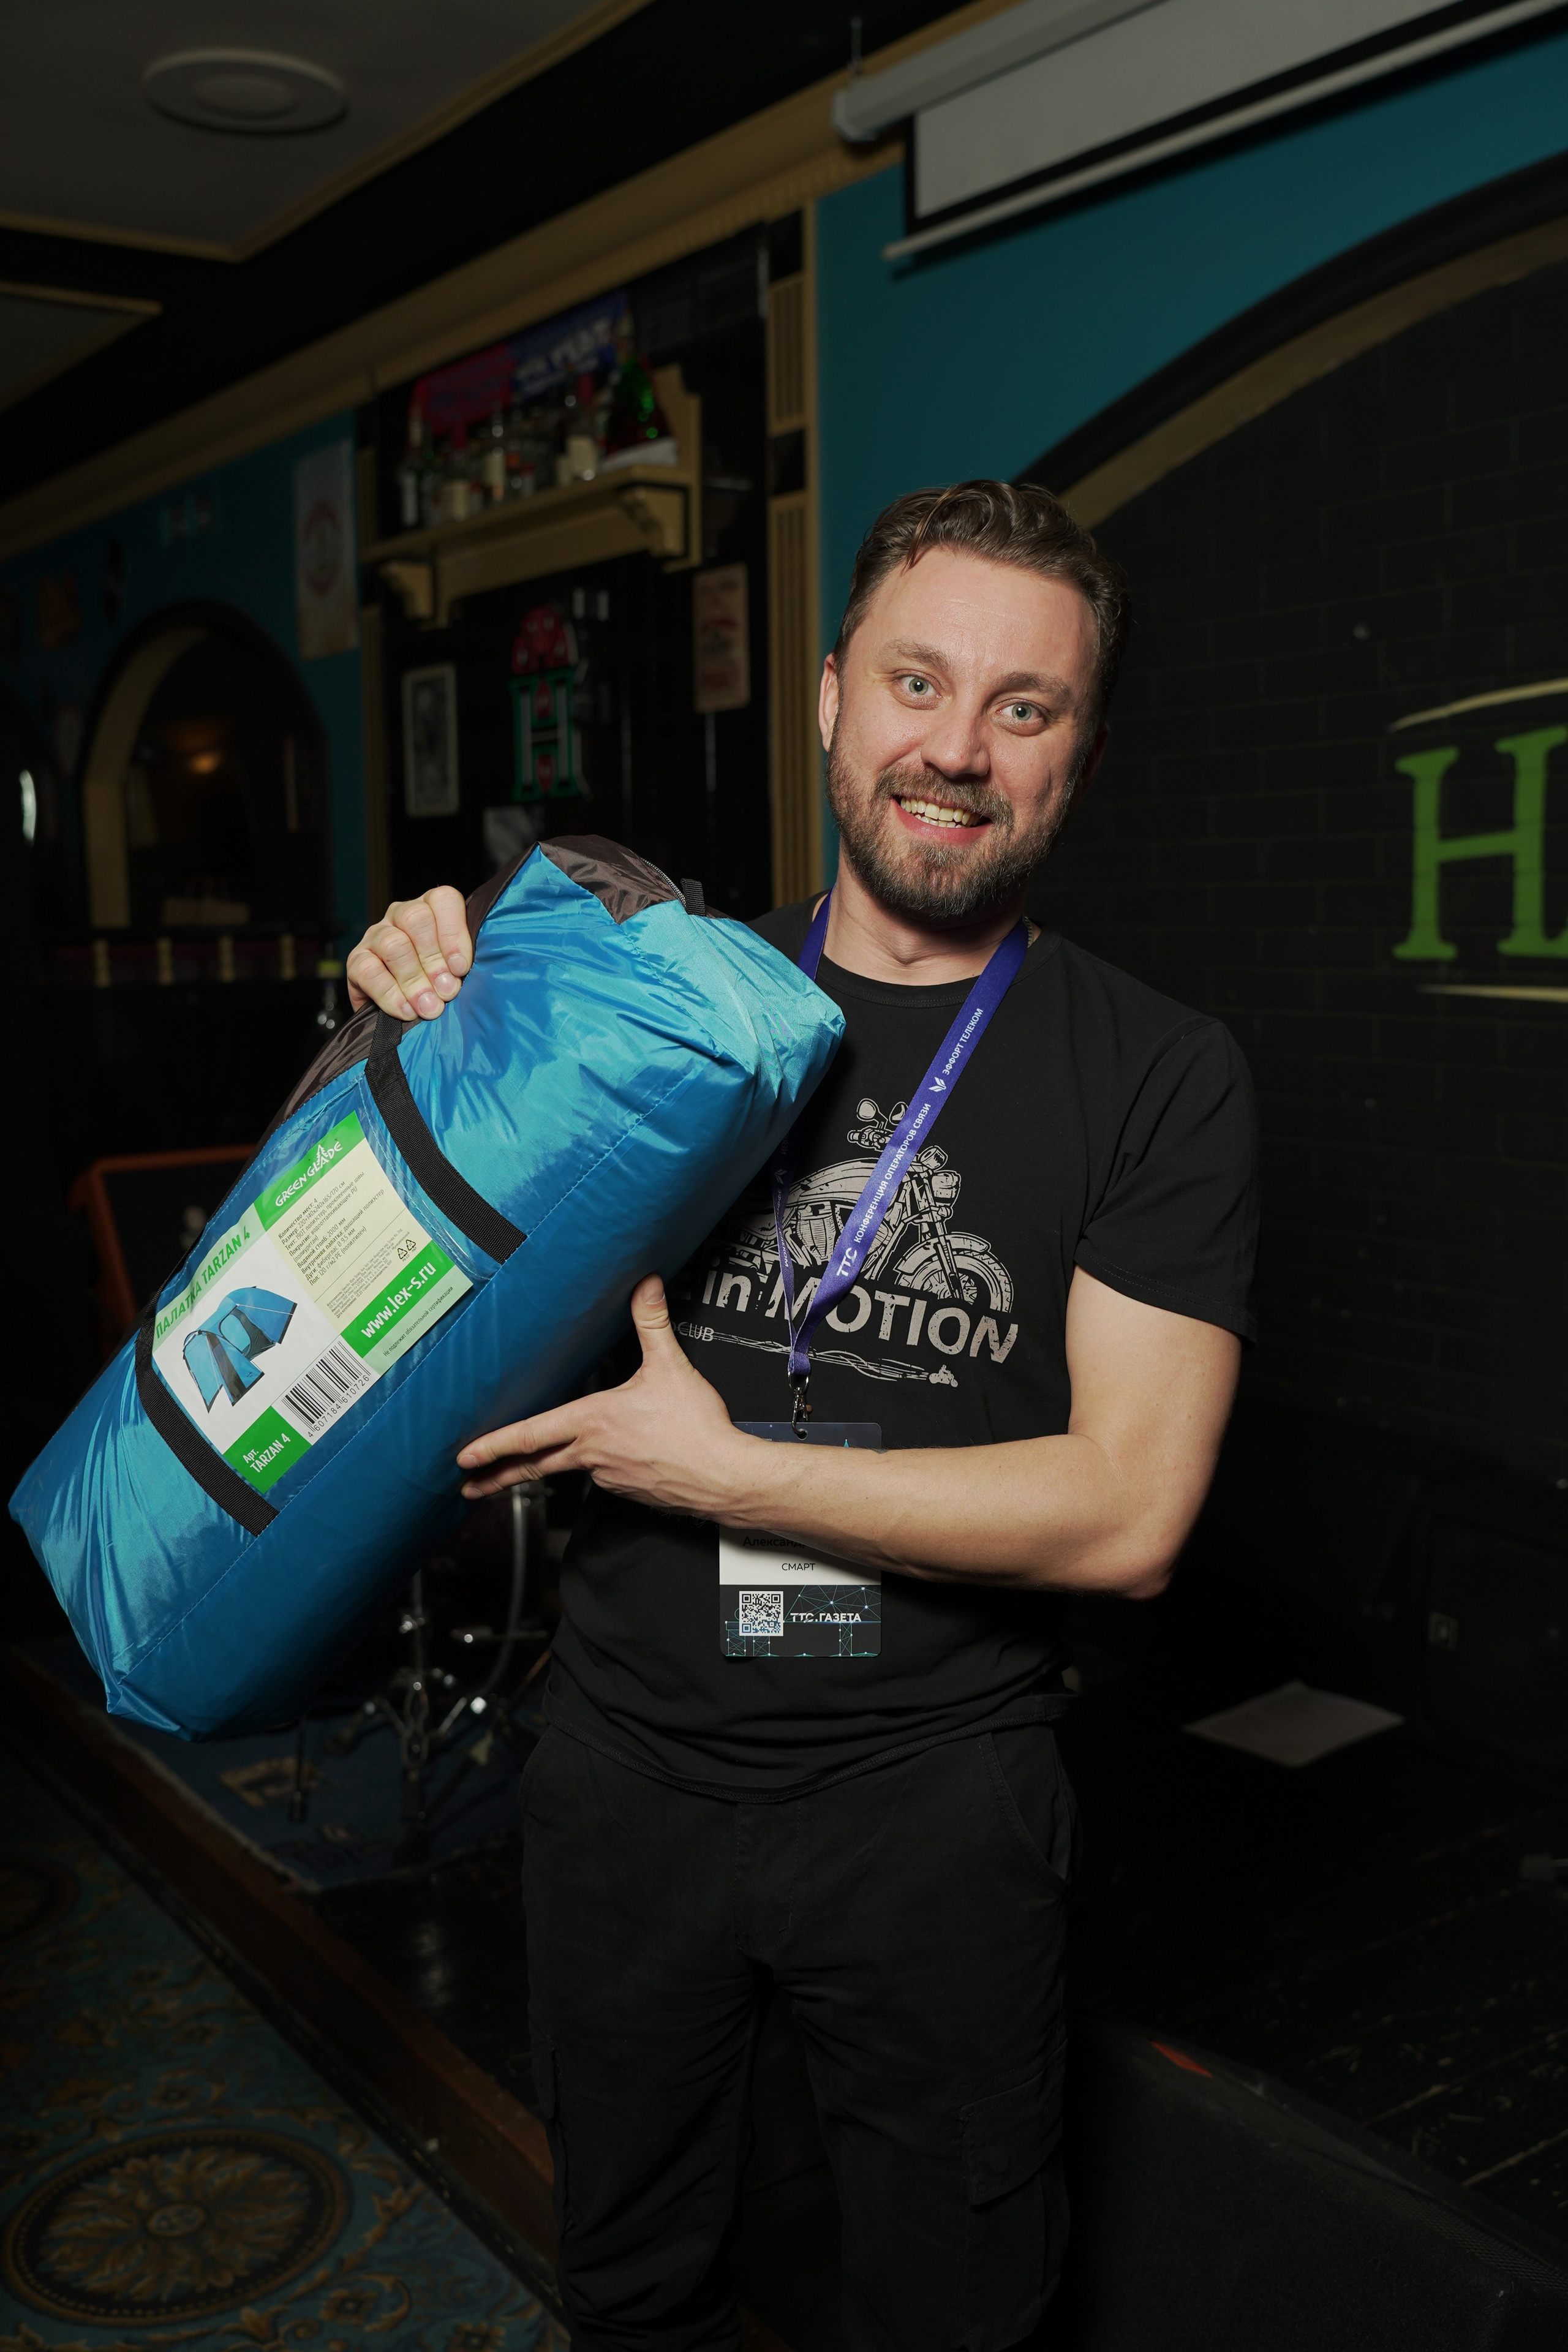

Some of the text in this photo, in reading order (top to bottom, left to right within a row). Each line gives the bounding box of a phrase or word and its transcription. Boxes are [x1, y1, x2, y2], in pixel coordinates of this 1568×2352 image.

[1392, 725, 1568, 962] H
[943, 1008, 984, 1075] ЭФФОРТ ТЕЛЕКОМ
[276, 1142, 342, 1206] GREEN GLADE
[854, 1180, 888, 1243] КОНФЕРЕНЦИЯ
[884, 1129, 916, 1180] ОПЕРАТОРОВ
[913, 1103, 931, 1129] СВЯЗИ
[279, 1215, 302, 1239] Количество
[303, 1204, 312, 1215] мест:
[282, 1229, 298, 1245] Размер:
[285, 1239, 295, 1250] Тент:
[306, 1210, 326, 1231] полиэстер,
[326, 1182, 353, 1209] проклеенные
[354, 1172, 364, 1182] швы
[289, 1186, 357, 1256] Покрытие: водоотталкивающее PU
[301, 1189, 383, 1274] Внутренняя палатка: дышащий полиэстер
[293, 1235, 318, 1263] (полиуретан)
[298, 1250, 315, 1268] Водяной
[315, 1237, 327, 1250] столб:
[327, 1224, 338, 1237] 2000
[306, 1268, 316, 1280] Дуги:
[317, 1246, 337, 1268] фиберглас
[309, 1276, 318, 1285] Пол:
[326, 1257, 336, 1269] г/м2
[341, 1226, 366, 1254] (полиэтилен)
[157, 1226, 251, 1338] ПАЛАТКА TARZAN 4
[361, 1262, 436, 1338] www.lex-s.ru
[702, 1256, 752, 1313] in
[764, 1270, 1019, 1363] MOTION
[389, 1334, 405, 1351] подлежит
[405, 1311, 429, 1335] обязательной
[429, 1287, 453, 1311] сертификации
[243, 1449, 258, 1463] Арт.
[250, 1433, 290, 1472] TARZAN 4
[782, 1562, 816, 1571] СМАРТ
[790, 1612, 862, 1623] ТТС.ГАЗЕТА
